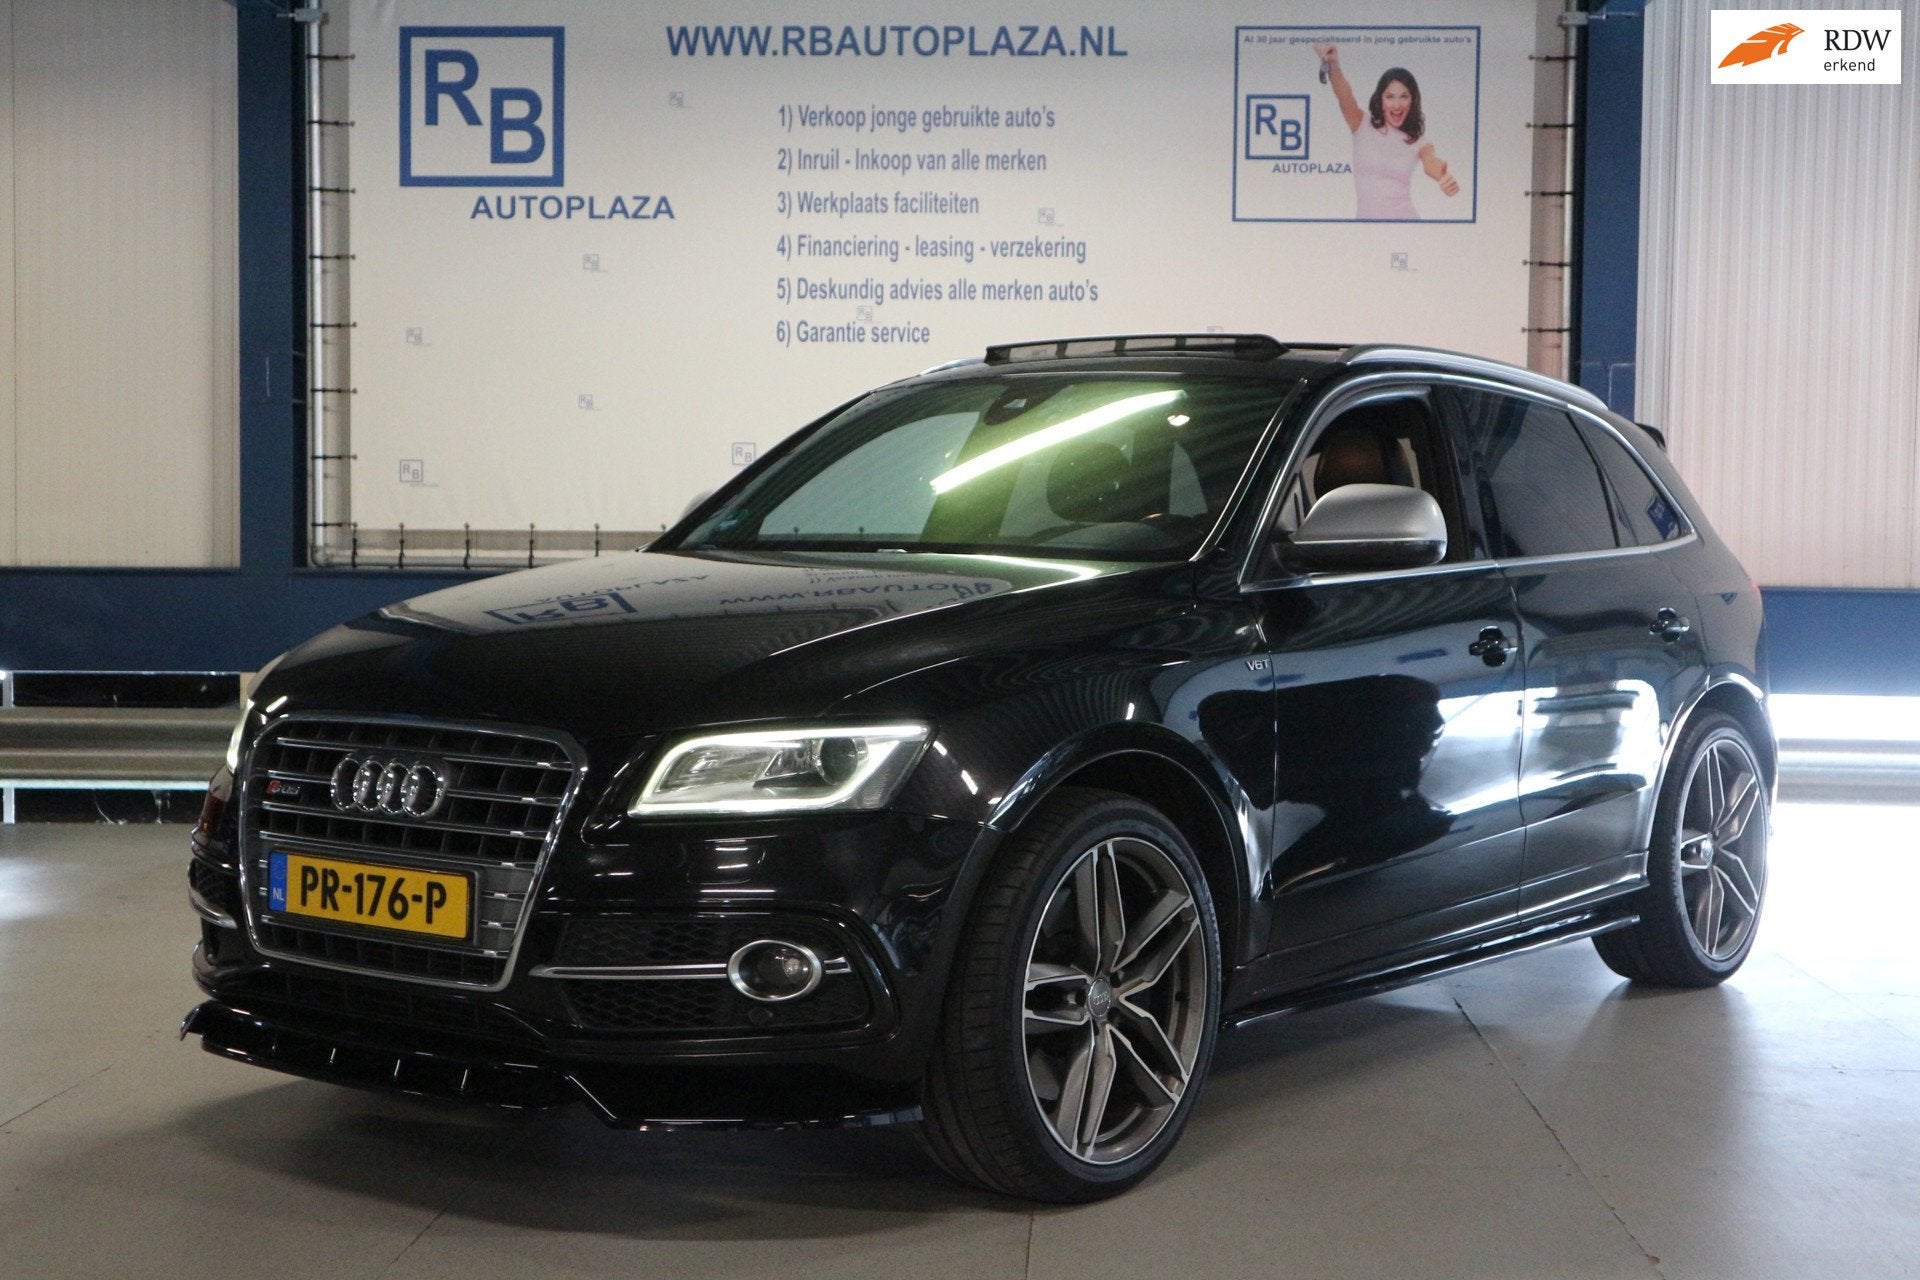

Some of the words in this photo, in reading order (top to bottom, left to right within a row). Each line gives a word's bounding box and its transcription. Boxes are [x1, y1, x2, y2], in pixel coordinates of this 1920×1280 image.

[666, 25, 1129, 57] WWW.RBAUTOPLAZA.NL
[1269, 35, 1286, 45] jaar
[1363, 35, 1373, 43] in
[1398, 35, 1441, 45] gebruikte
[1443, 35, 1472, 44] auto's
[424, 49, 545, 164] RB
[778, 105, 793, 133] 1)
[799, 105, 866, 134] Verkoop
[870, 105, 917, 133] jonge
[922, 105, 1000, 133] gebruikte
[1005, 105, 1055, 128] auto's
[777, 148, 793, 175] 2)
[797, 148, 840, 171] Inruil
[855, 148, 912, 175] Inkoop
[917, 154, 946, 171] van
[951, 148, 980, 171] alle
[985, 148, 1047, 171] merken
[1272, 163, 1352, 175] AUTOPLAZA
[470, 195, 675, 220] AUTOPLAZA
[777, 191, 792, 218] 3)
[797, 191, 889, 219] Werkplaats
[894, 191, 979, 214] faciliteiten
[777, 235, 792, 262] 4)
[797, 234, 899, 262] Financiering
[915, 235, 974, 263] leasing
[990, 235, 1087, 264] verzekering
[777, 278, 791, 305] 5)
[797, 277, 884, 305] Deskundig
[889, 278, 943, 301] advies
[948, 278, 977, 301] alle
[982, 279, 1043, 301] merken
[1048, 279, 1099, 302] auto's
[776, 320, 791, 348] 6)
[796, 320, 866, 343] Garantie
[871, 322, 930, 343] service
[1245, 658, 1270, 671] V6T
[272, 888, 284, 901] NL
[301, 865, 447, 925] PR-176-P
